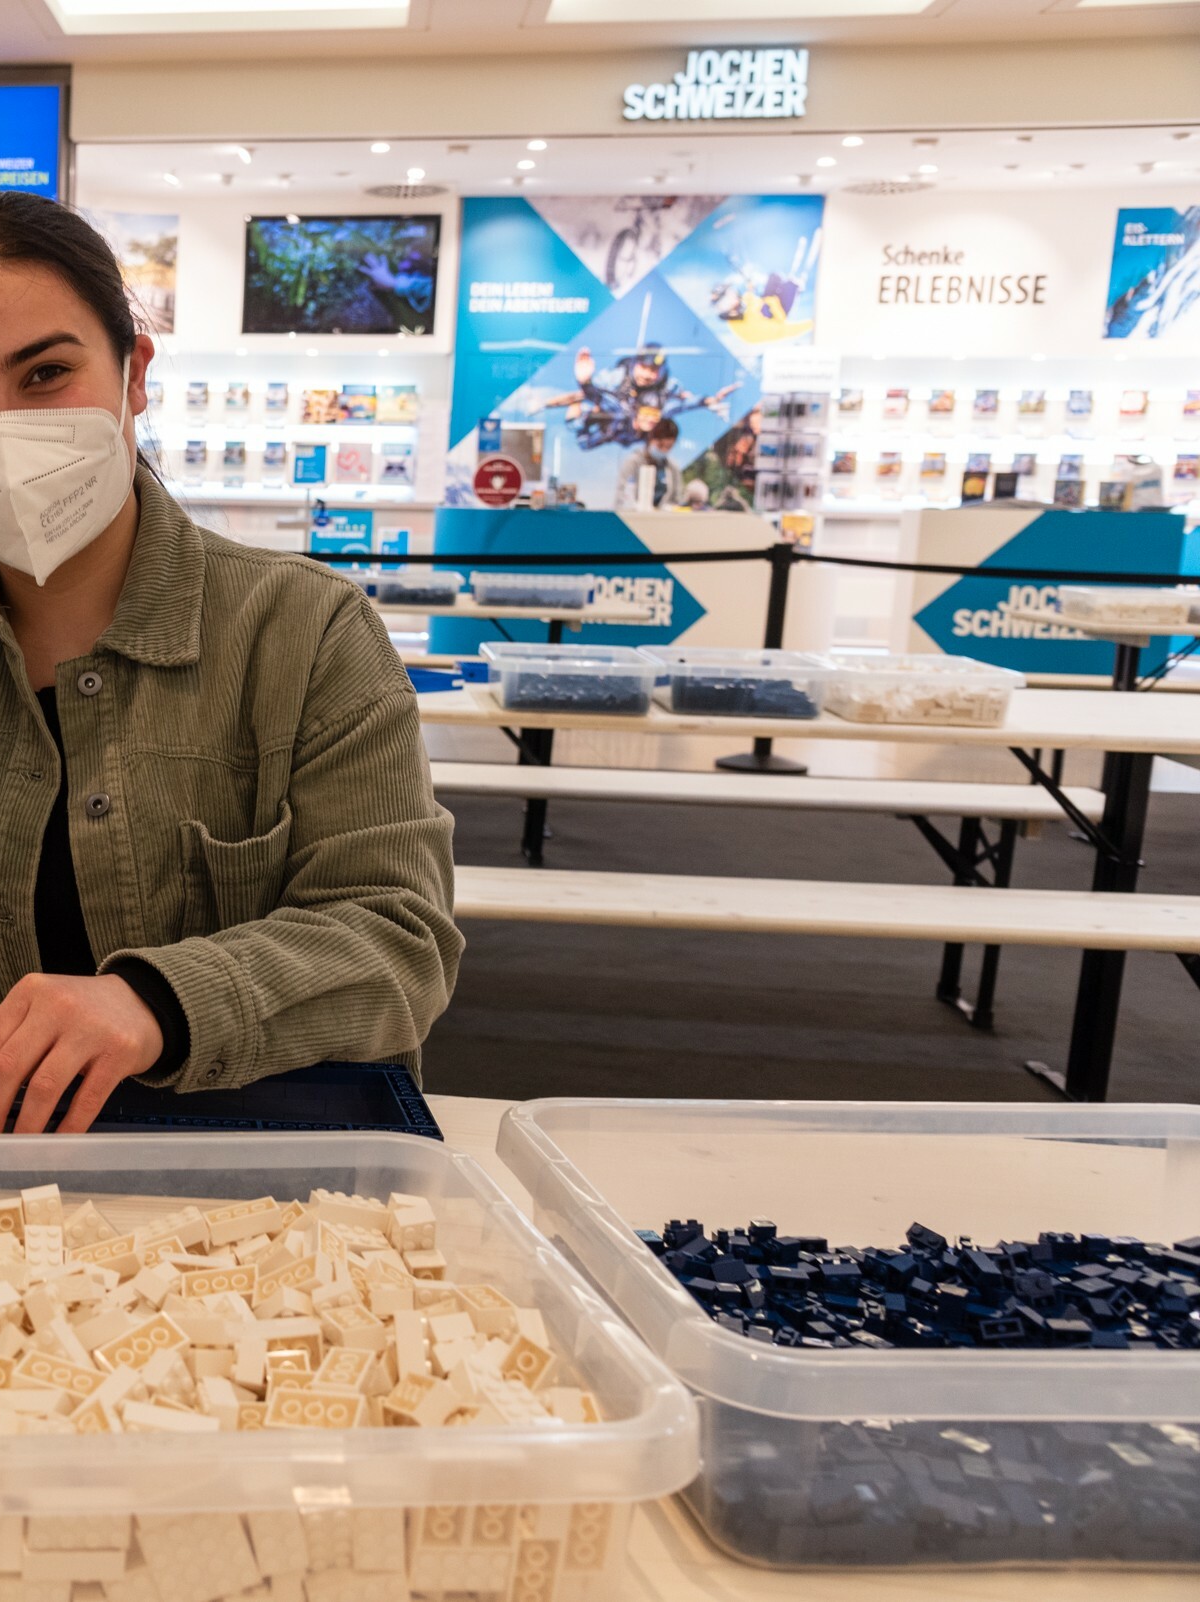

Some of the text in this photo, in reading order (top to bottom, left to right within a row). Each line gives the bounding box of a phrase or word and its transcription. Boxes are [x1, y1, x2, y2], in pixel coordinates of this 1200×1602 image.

[674, 49, 809, 85] JOCHEN
[623, 83, 808, 120] SCHWEIZER
[882, 244, 965, 266] Schenke
[879, 275, 1048, 305] ERLEBNISSE
[63, 475, 98, 506] FFP2 NR
[594, 576, 674, 604] OCHEN
